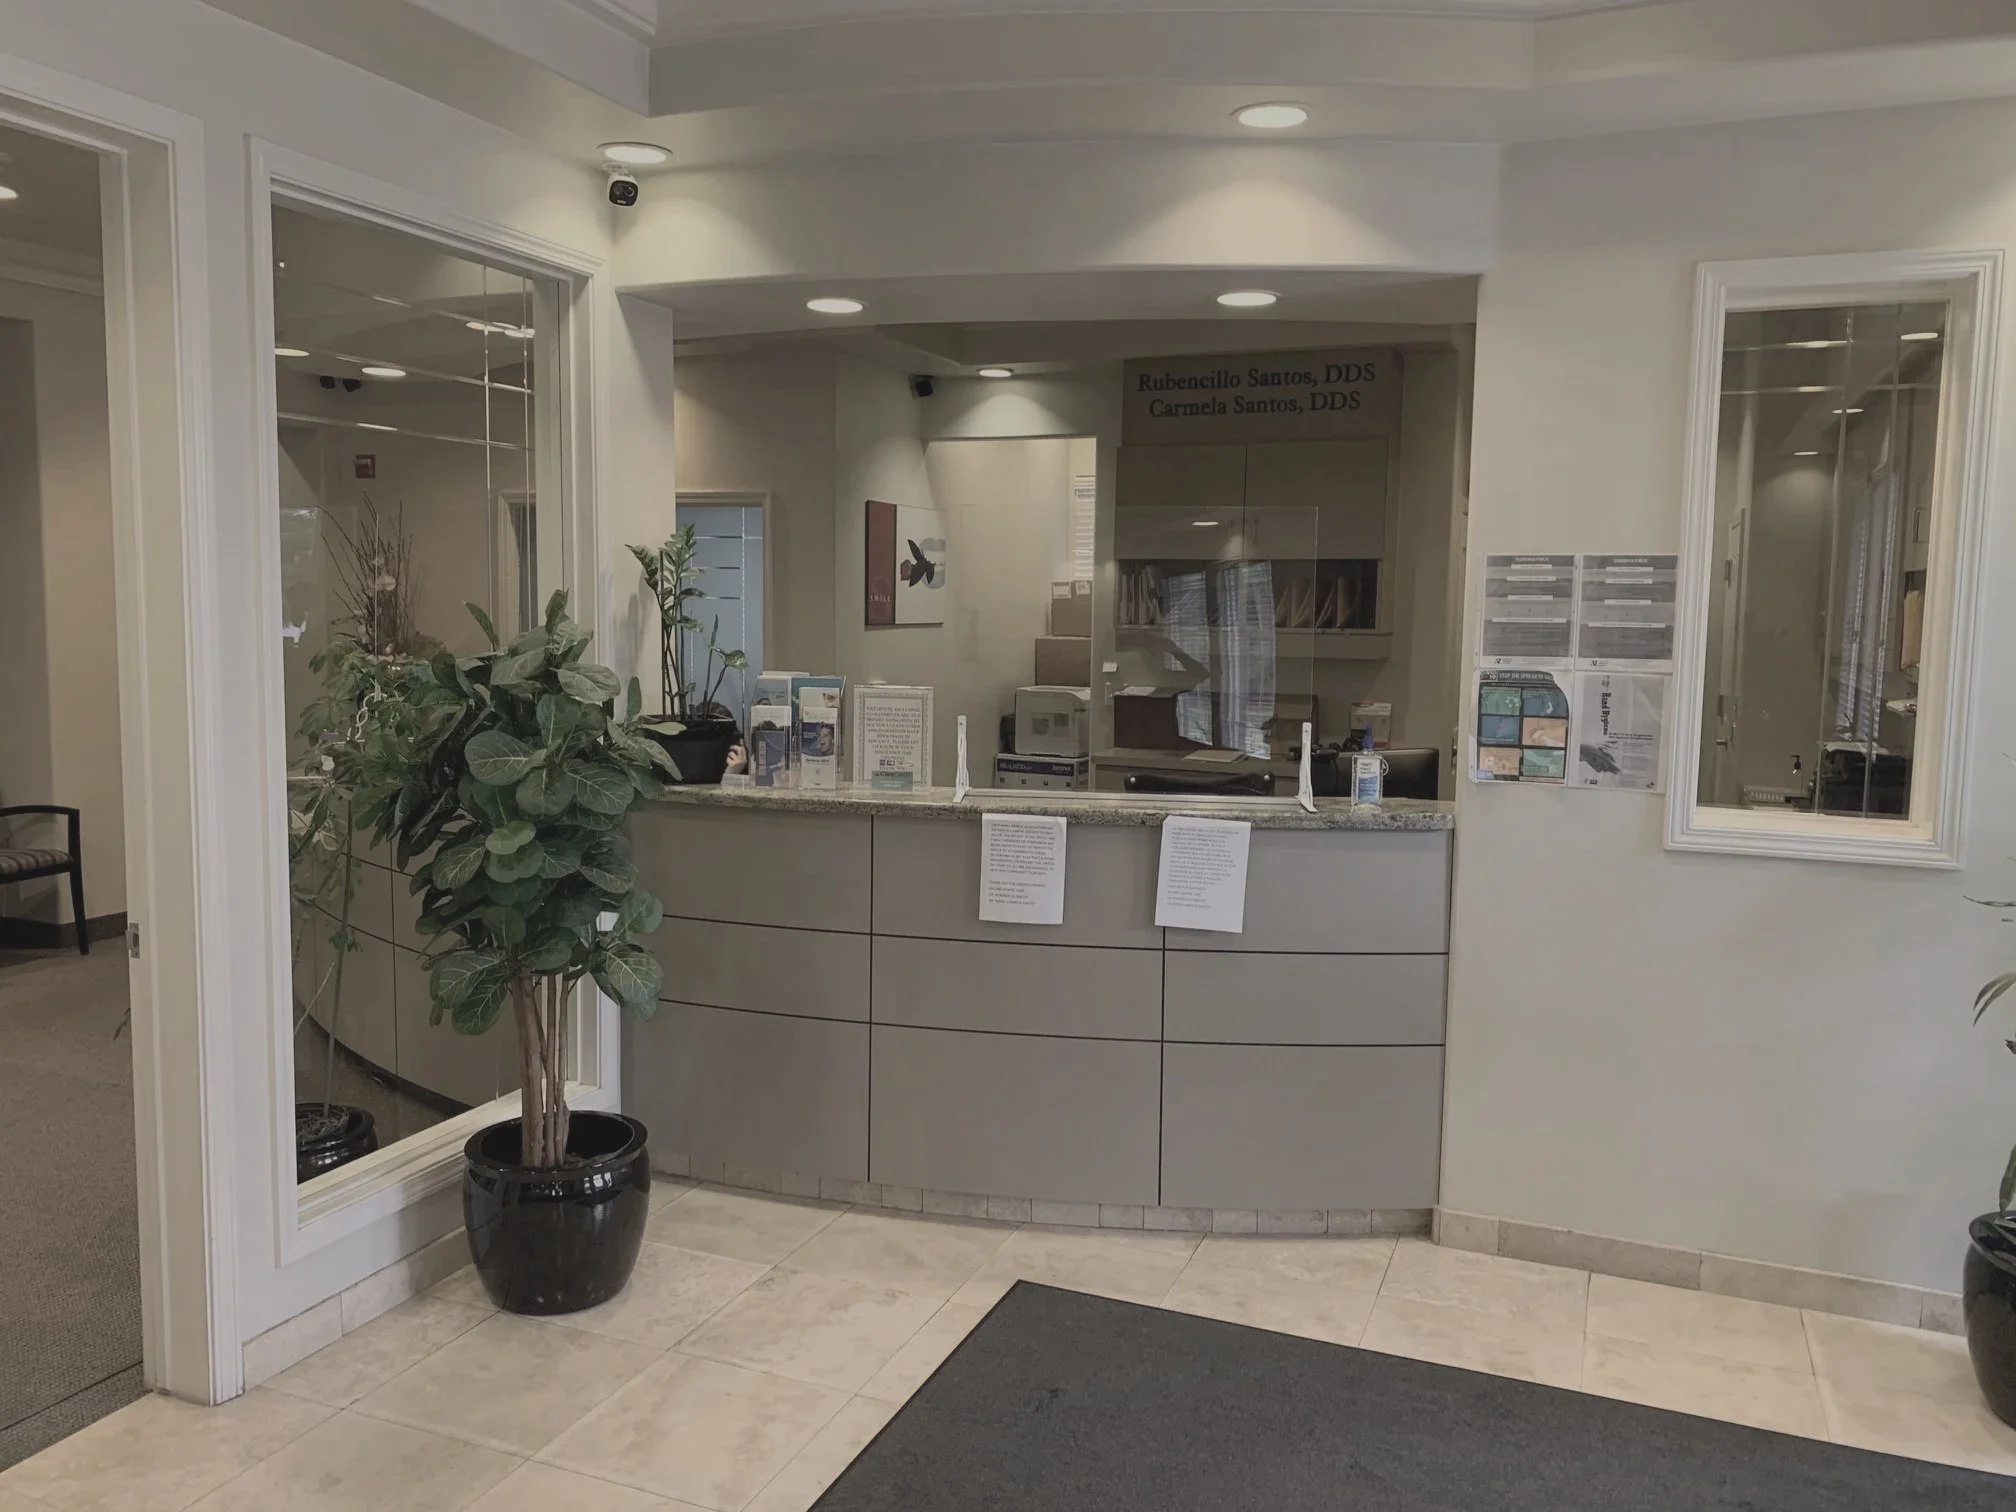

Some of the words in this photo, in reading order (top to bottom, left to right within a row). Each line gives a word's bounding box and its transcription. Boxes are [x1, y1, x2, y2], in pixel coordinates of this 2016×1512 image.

[1137, 370, 1241, 392] Rubencillo
[1247, 367, 1319, 388] Santos,
[1323, 362, 1376, 384] DDS
[1149, 396, 1228, 418] Carmela
[1233, 394, 1304, 416] Santos,
[1309, 391, 1361, 412] DDS
[870, 594, 891, 602] SMILE
[1601, 692, 1611, 710] Hand
[1600, 710, 1610, 736] Hygiene
